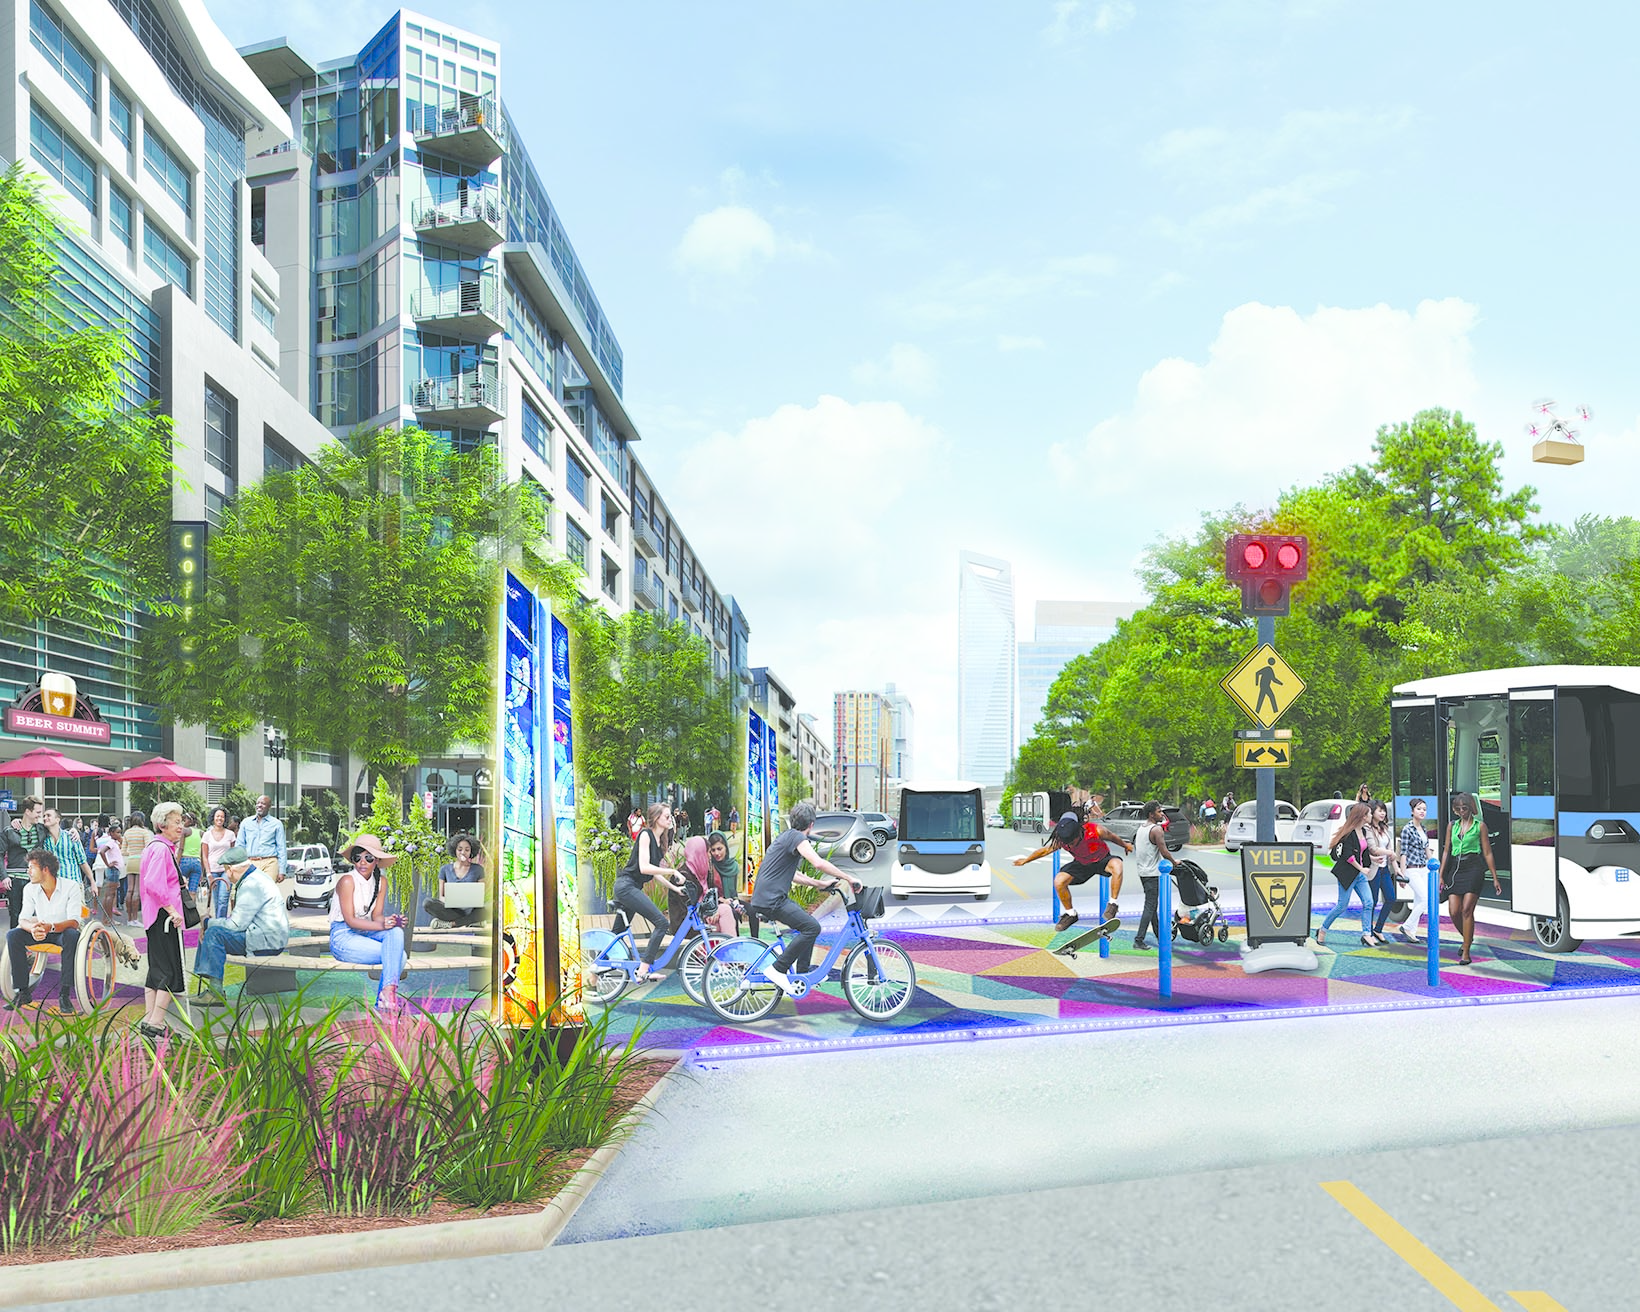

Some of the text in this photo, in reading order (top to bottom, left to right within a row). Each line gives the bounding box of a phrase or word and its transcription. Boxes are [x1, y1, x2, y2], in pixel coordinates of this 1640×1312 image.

[183, 534, 193, 671] COFF
[16, 715, 105, 737] BEER SUMMIT
[1249, 849, 1307, 866] YIELD
